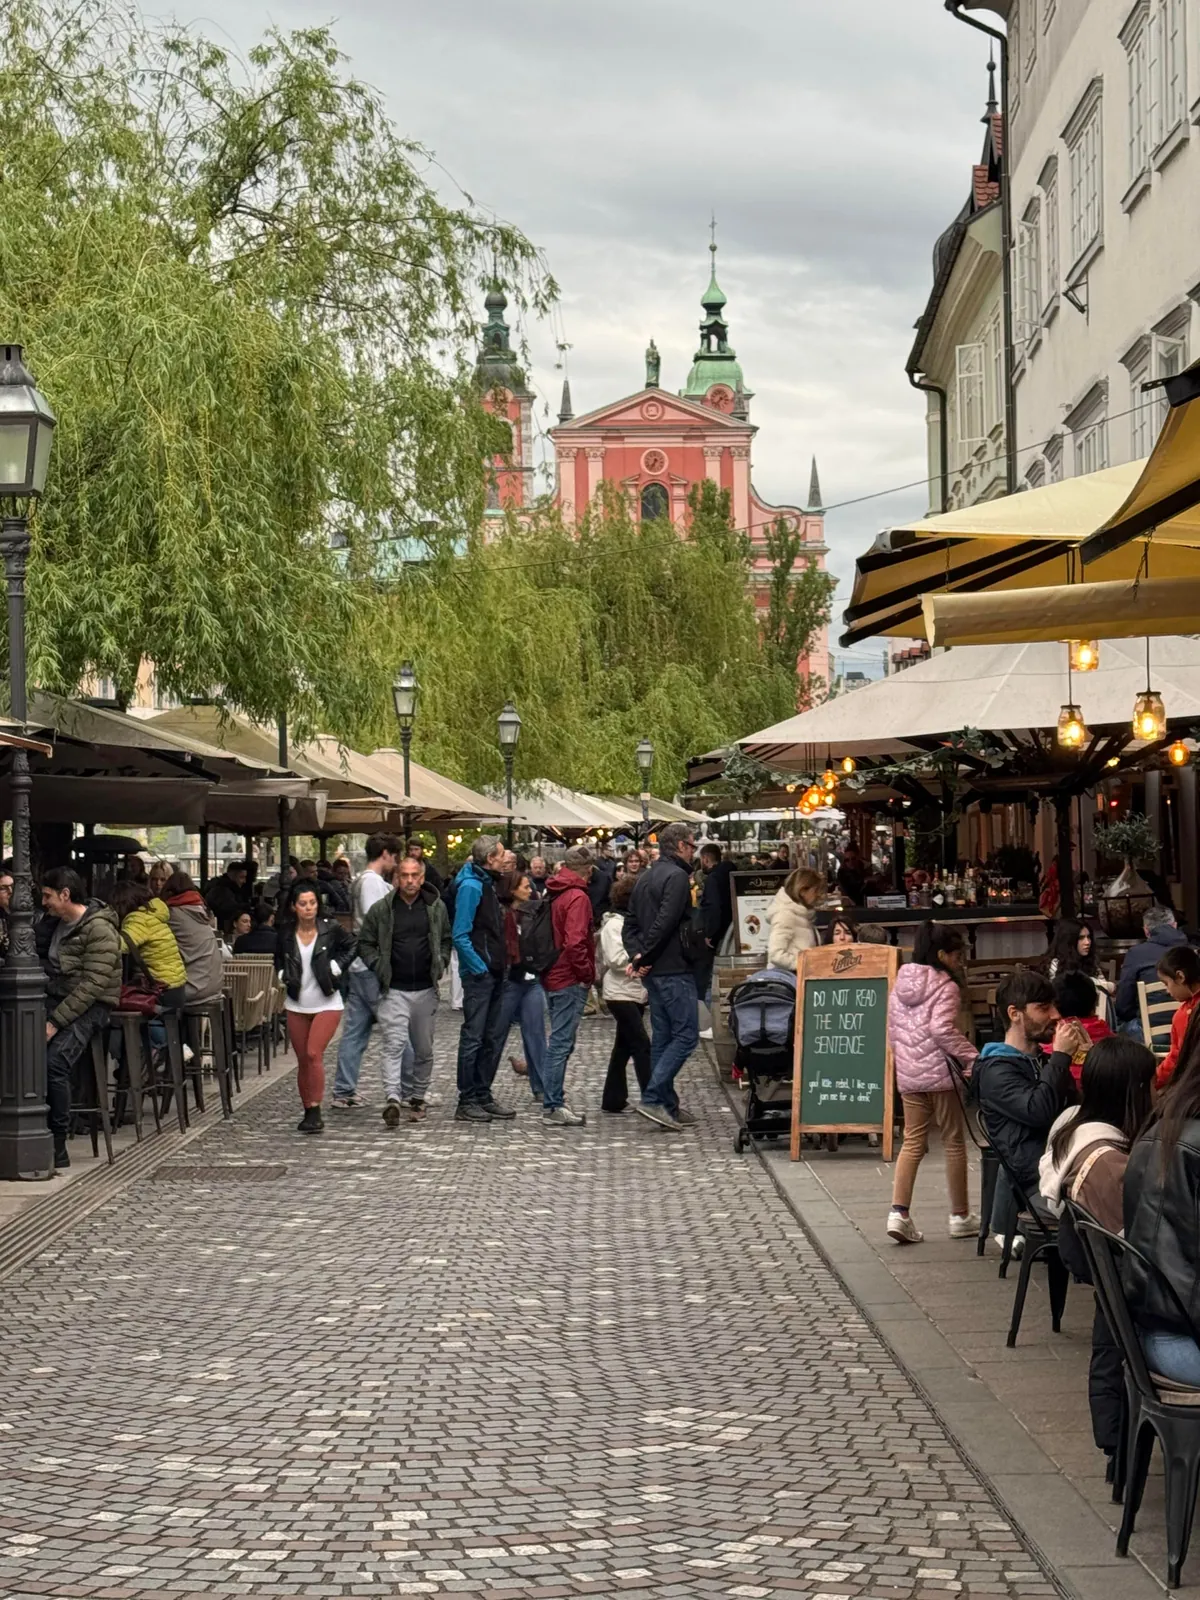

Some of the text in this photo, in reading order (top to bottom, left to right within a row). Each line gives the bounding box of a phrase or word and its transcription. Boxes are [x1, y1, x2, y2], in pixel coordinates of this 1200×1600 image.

[813, 989, 877, 1008] DO NOT READ
[813, 1013, 864, 1030] THE NEXT
[813, 1035, 866, 1054] SENTENCE
[857, 1079, 866, 1089] like
[850, 1094, 855, 1102] a
